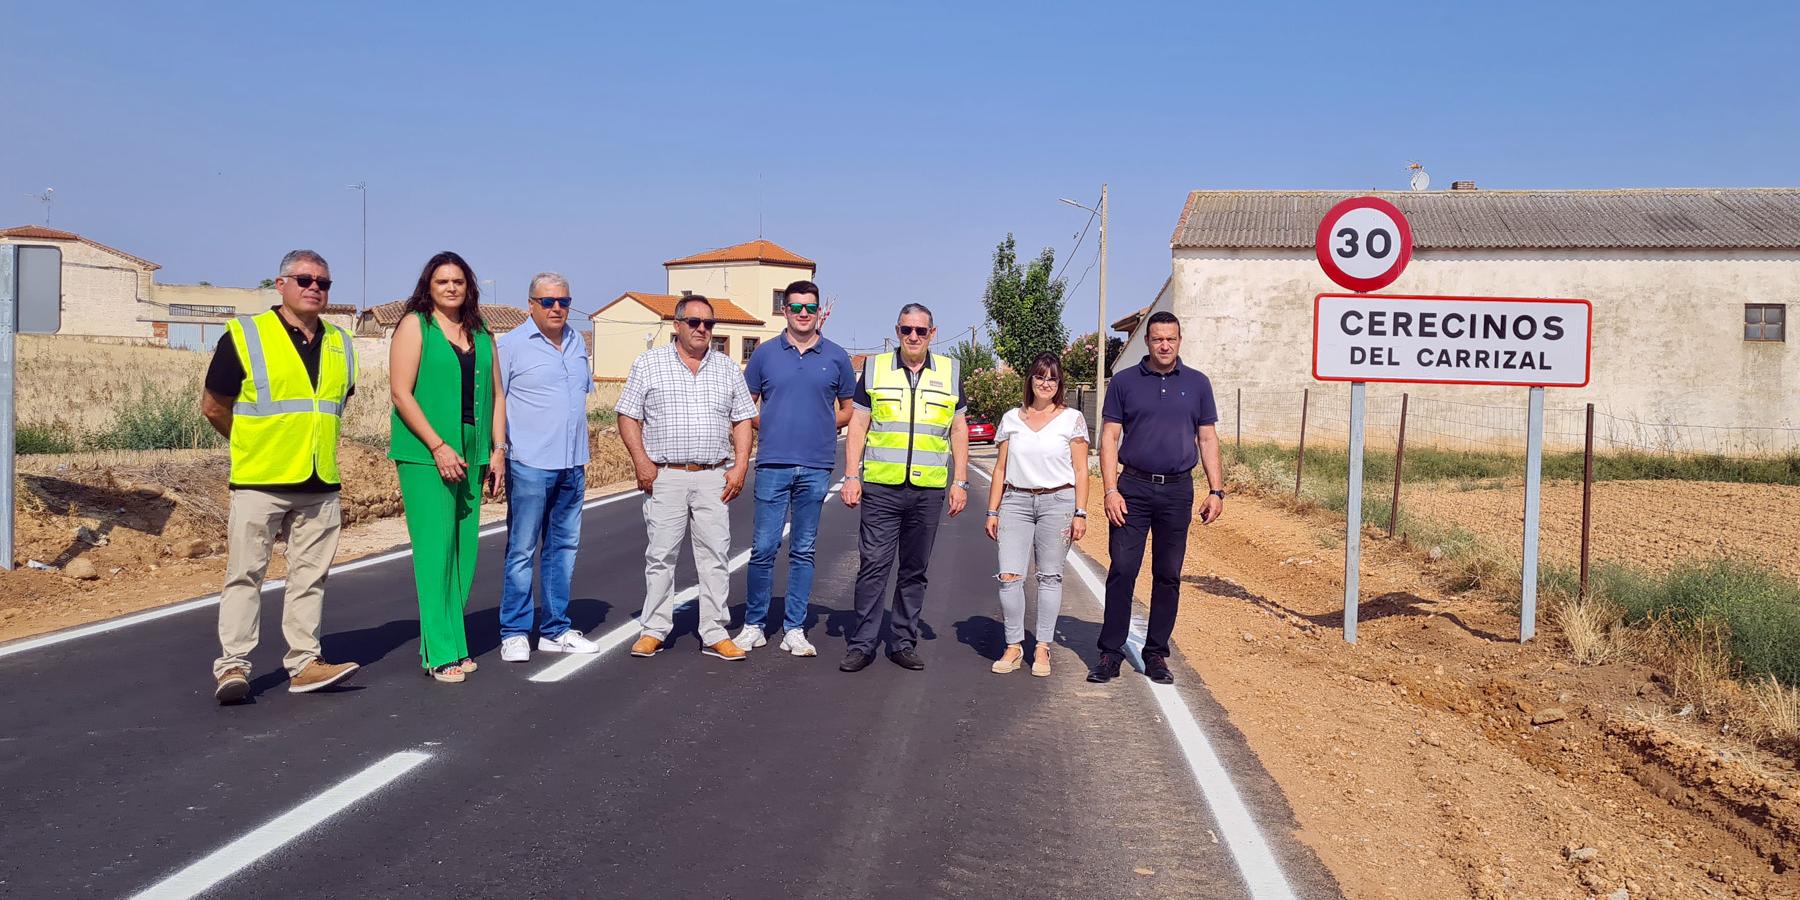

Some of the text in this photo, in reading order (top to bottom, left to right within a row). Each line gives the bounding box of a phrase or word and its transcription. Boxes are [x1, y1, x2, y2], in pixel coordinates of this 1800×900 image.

[1336, 227, 1392, 259] 30
[1340, 310, 1565, 341] CERECINOS
[1350, 346, 1553, 371] DEL CARRIZAL
